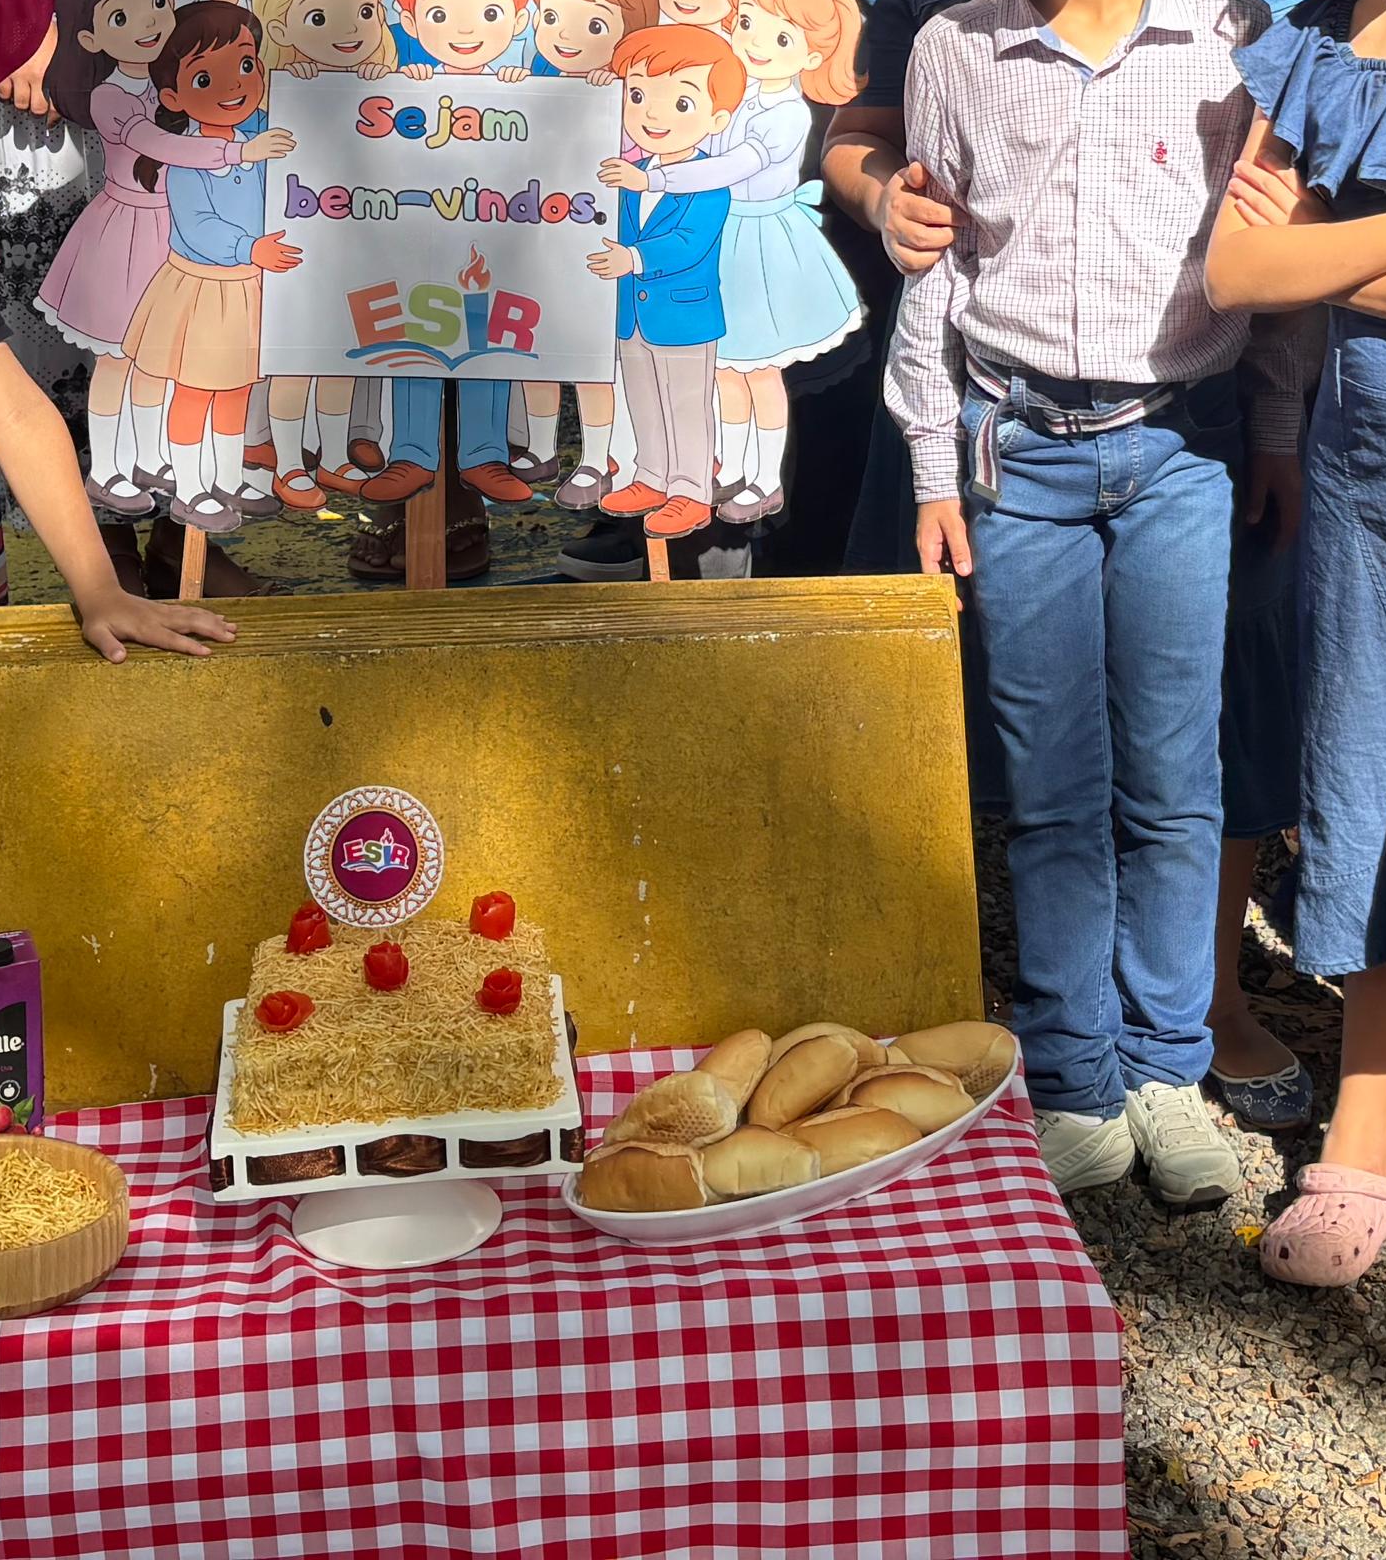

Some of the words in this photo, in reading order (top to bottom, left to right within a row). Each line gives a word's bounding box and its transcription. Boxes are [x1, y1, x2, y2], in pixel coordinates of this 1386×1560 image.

[356, 96, 527, 149] Sejam
[346, 278, 541, 354] ESIR
[343, 839, 410, 866] ESIR
